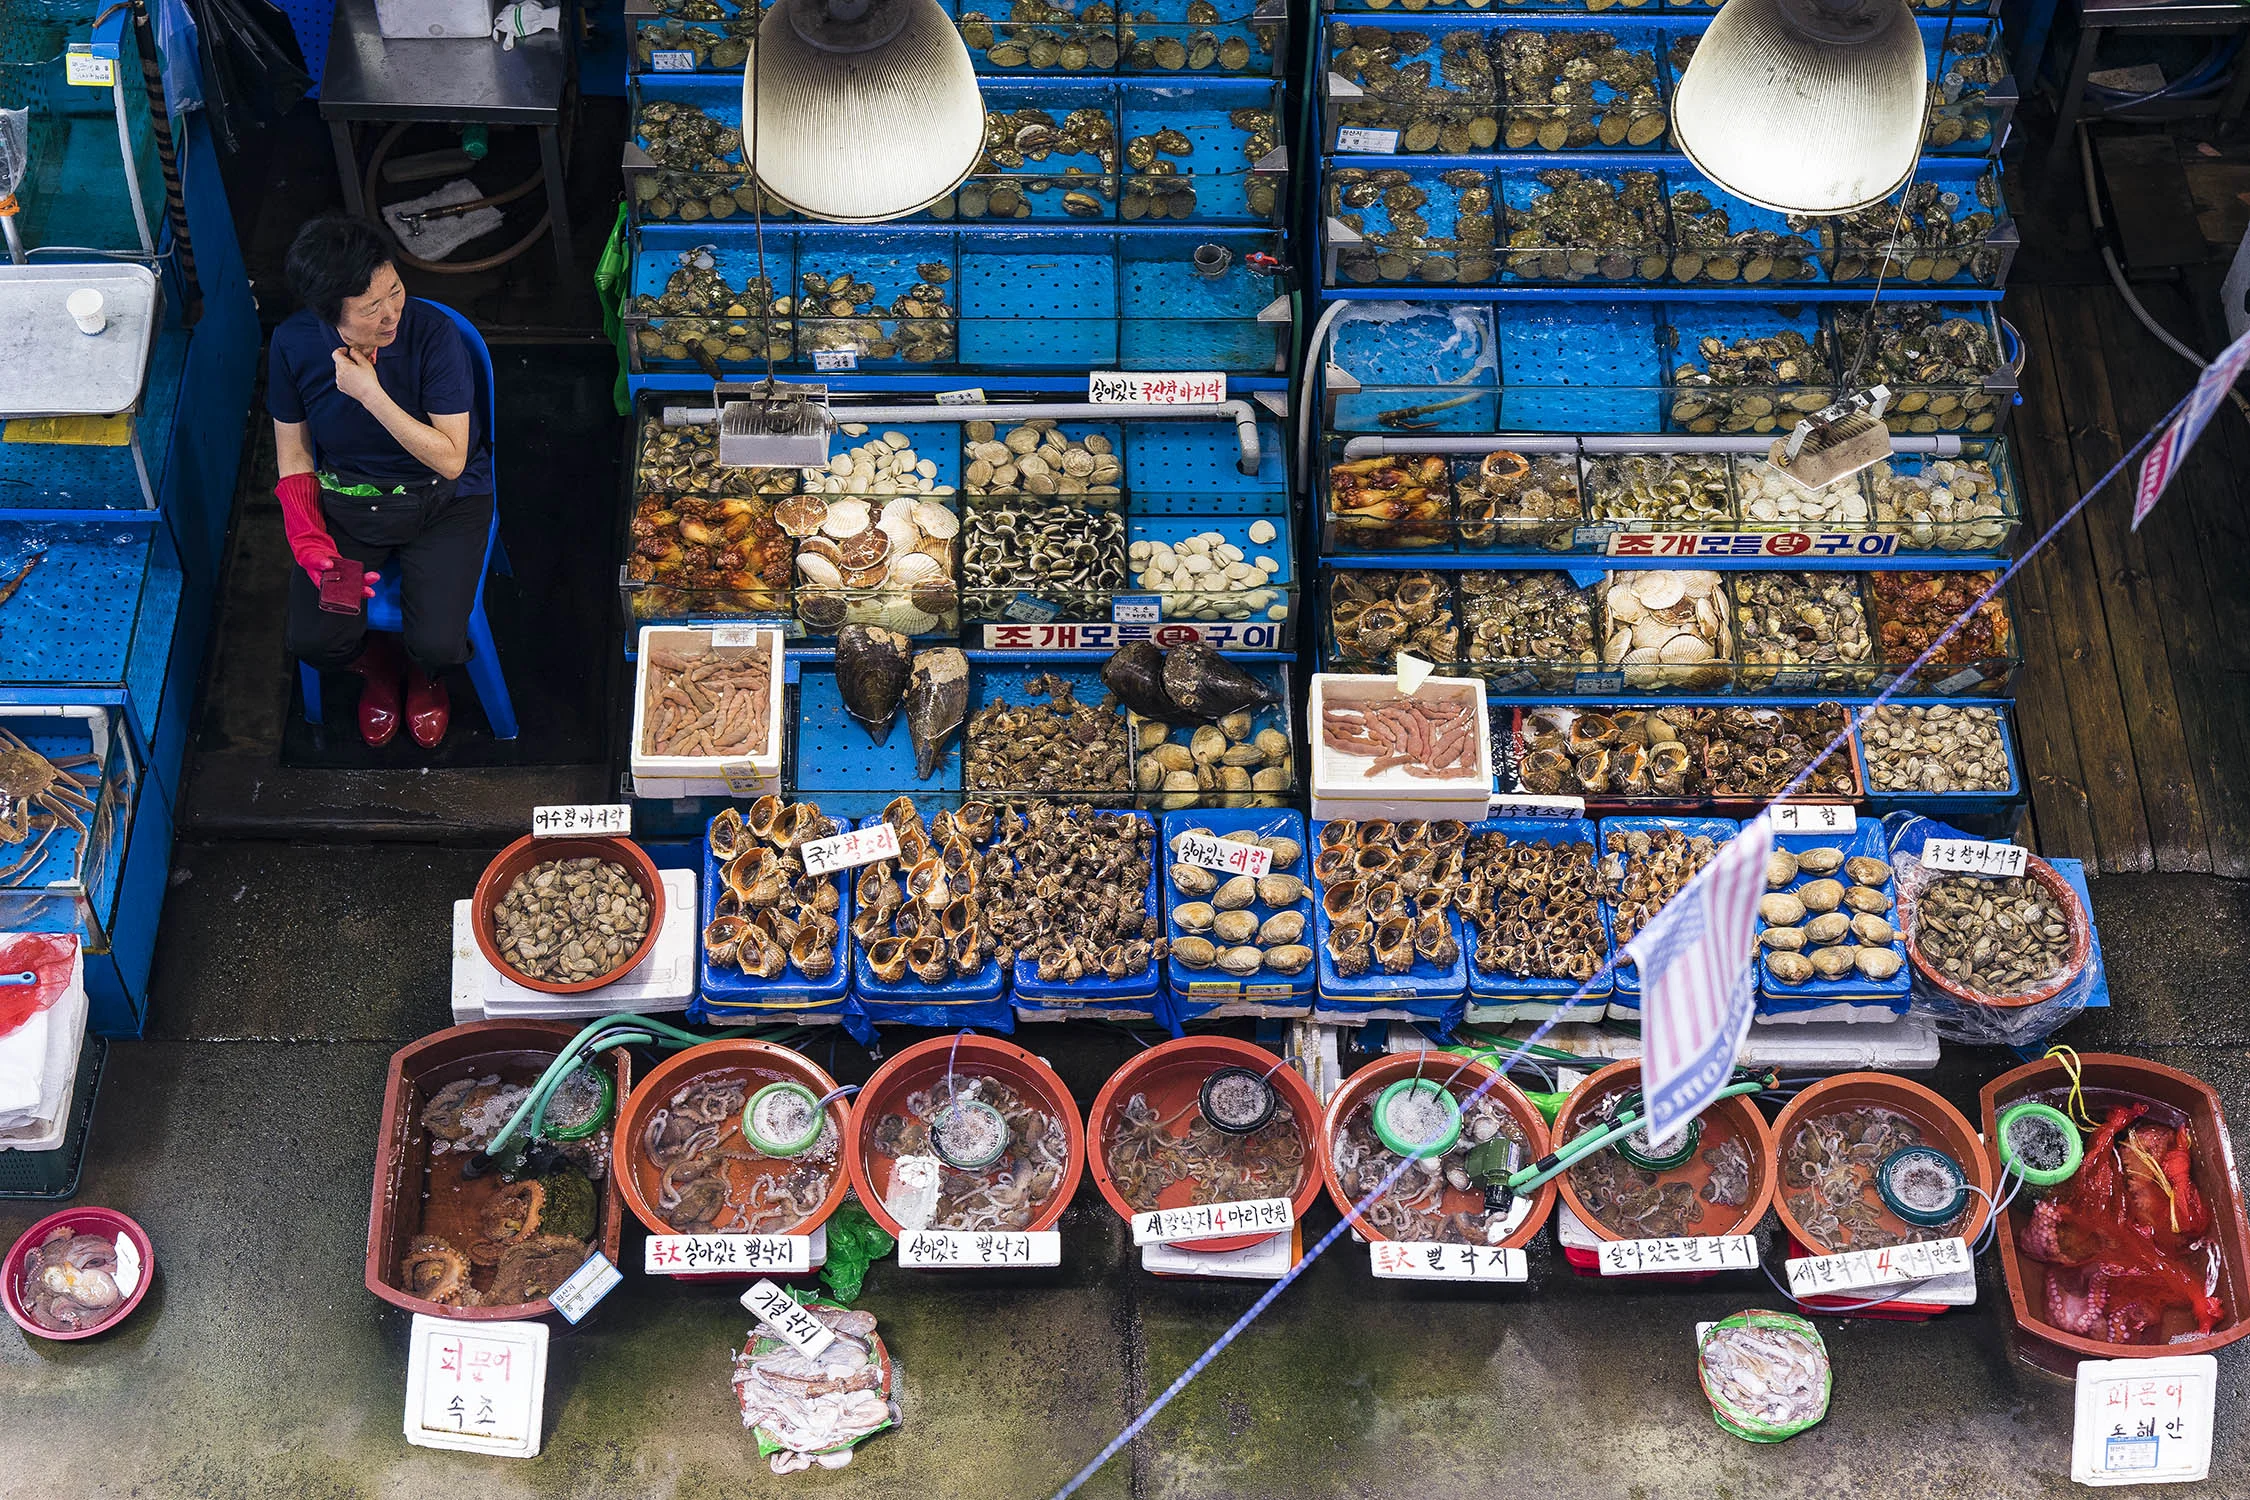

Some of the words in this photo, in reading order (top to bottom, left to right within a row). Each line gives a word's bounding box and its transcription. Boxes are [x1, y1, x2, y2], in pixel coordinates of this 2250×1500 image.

[1092, 378, 1137, 402] 살아있는
[1182, 837, 1226, 867] 살아있는
[1229, 847, 1267, 875] 대합
[685, 1237, 737, 1268] 살아있는
[743, 1237, 793, 1268] 뻘낙지
[909, 1233, 959, 1263] 살아있는
[975, 1233, 1030, 1263] 뻘낙지
[447, 1394, 496, 1429] 속초
